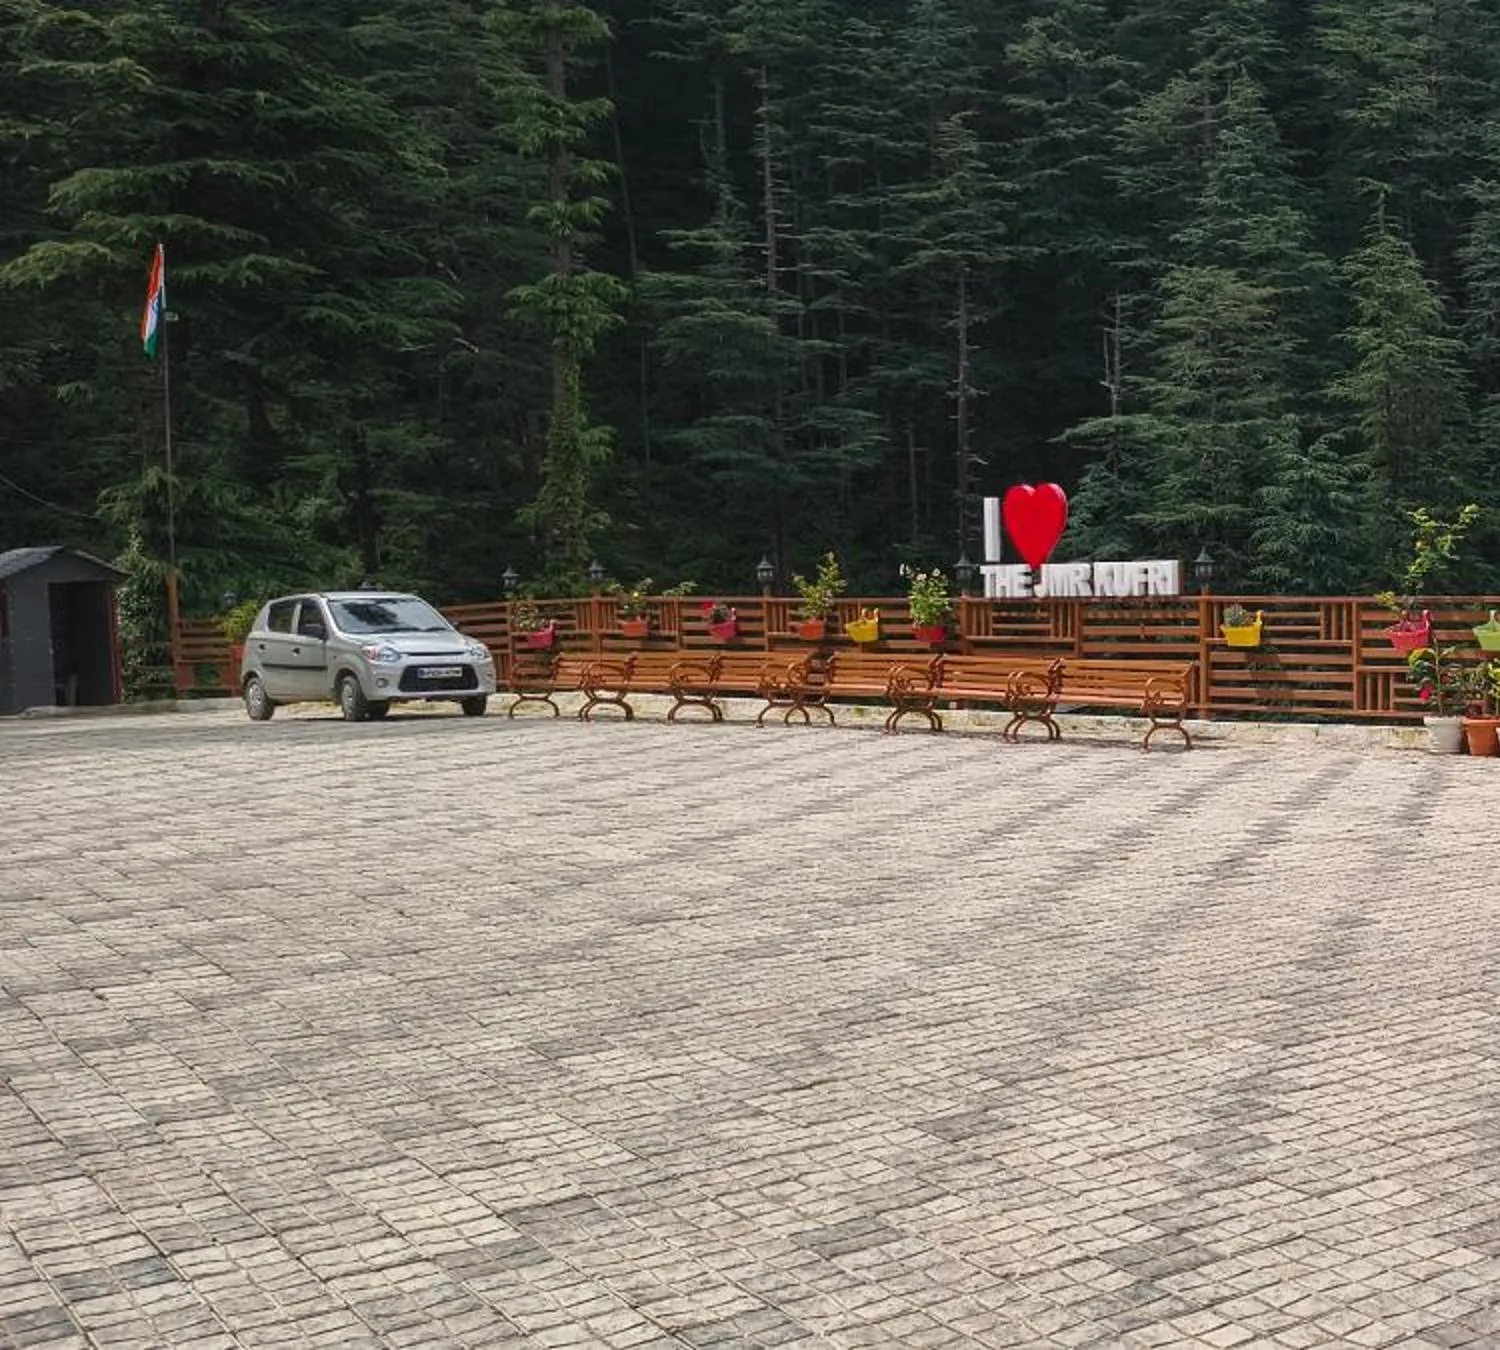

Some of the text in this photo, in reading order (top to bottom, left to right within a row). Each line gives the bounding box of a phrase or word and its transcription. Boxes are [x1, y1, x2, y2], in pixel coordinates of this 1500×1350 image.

[983, 497, 1000, 562] I
[980, 560, 1179, 598] THE JMR KUFRI
